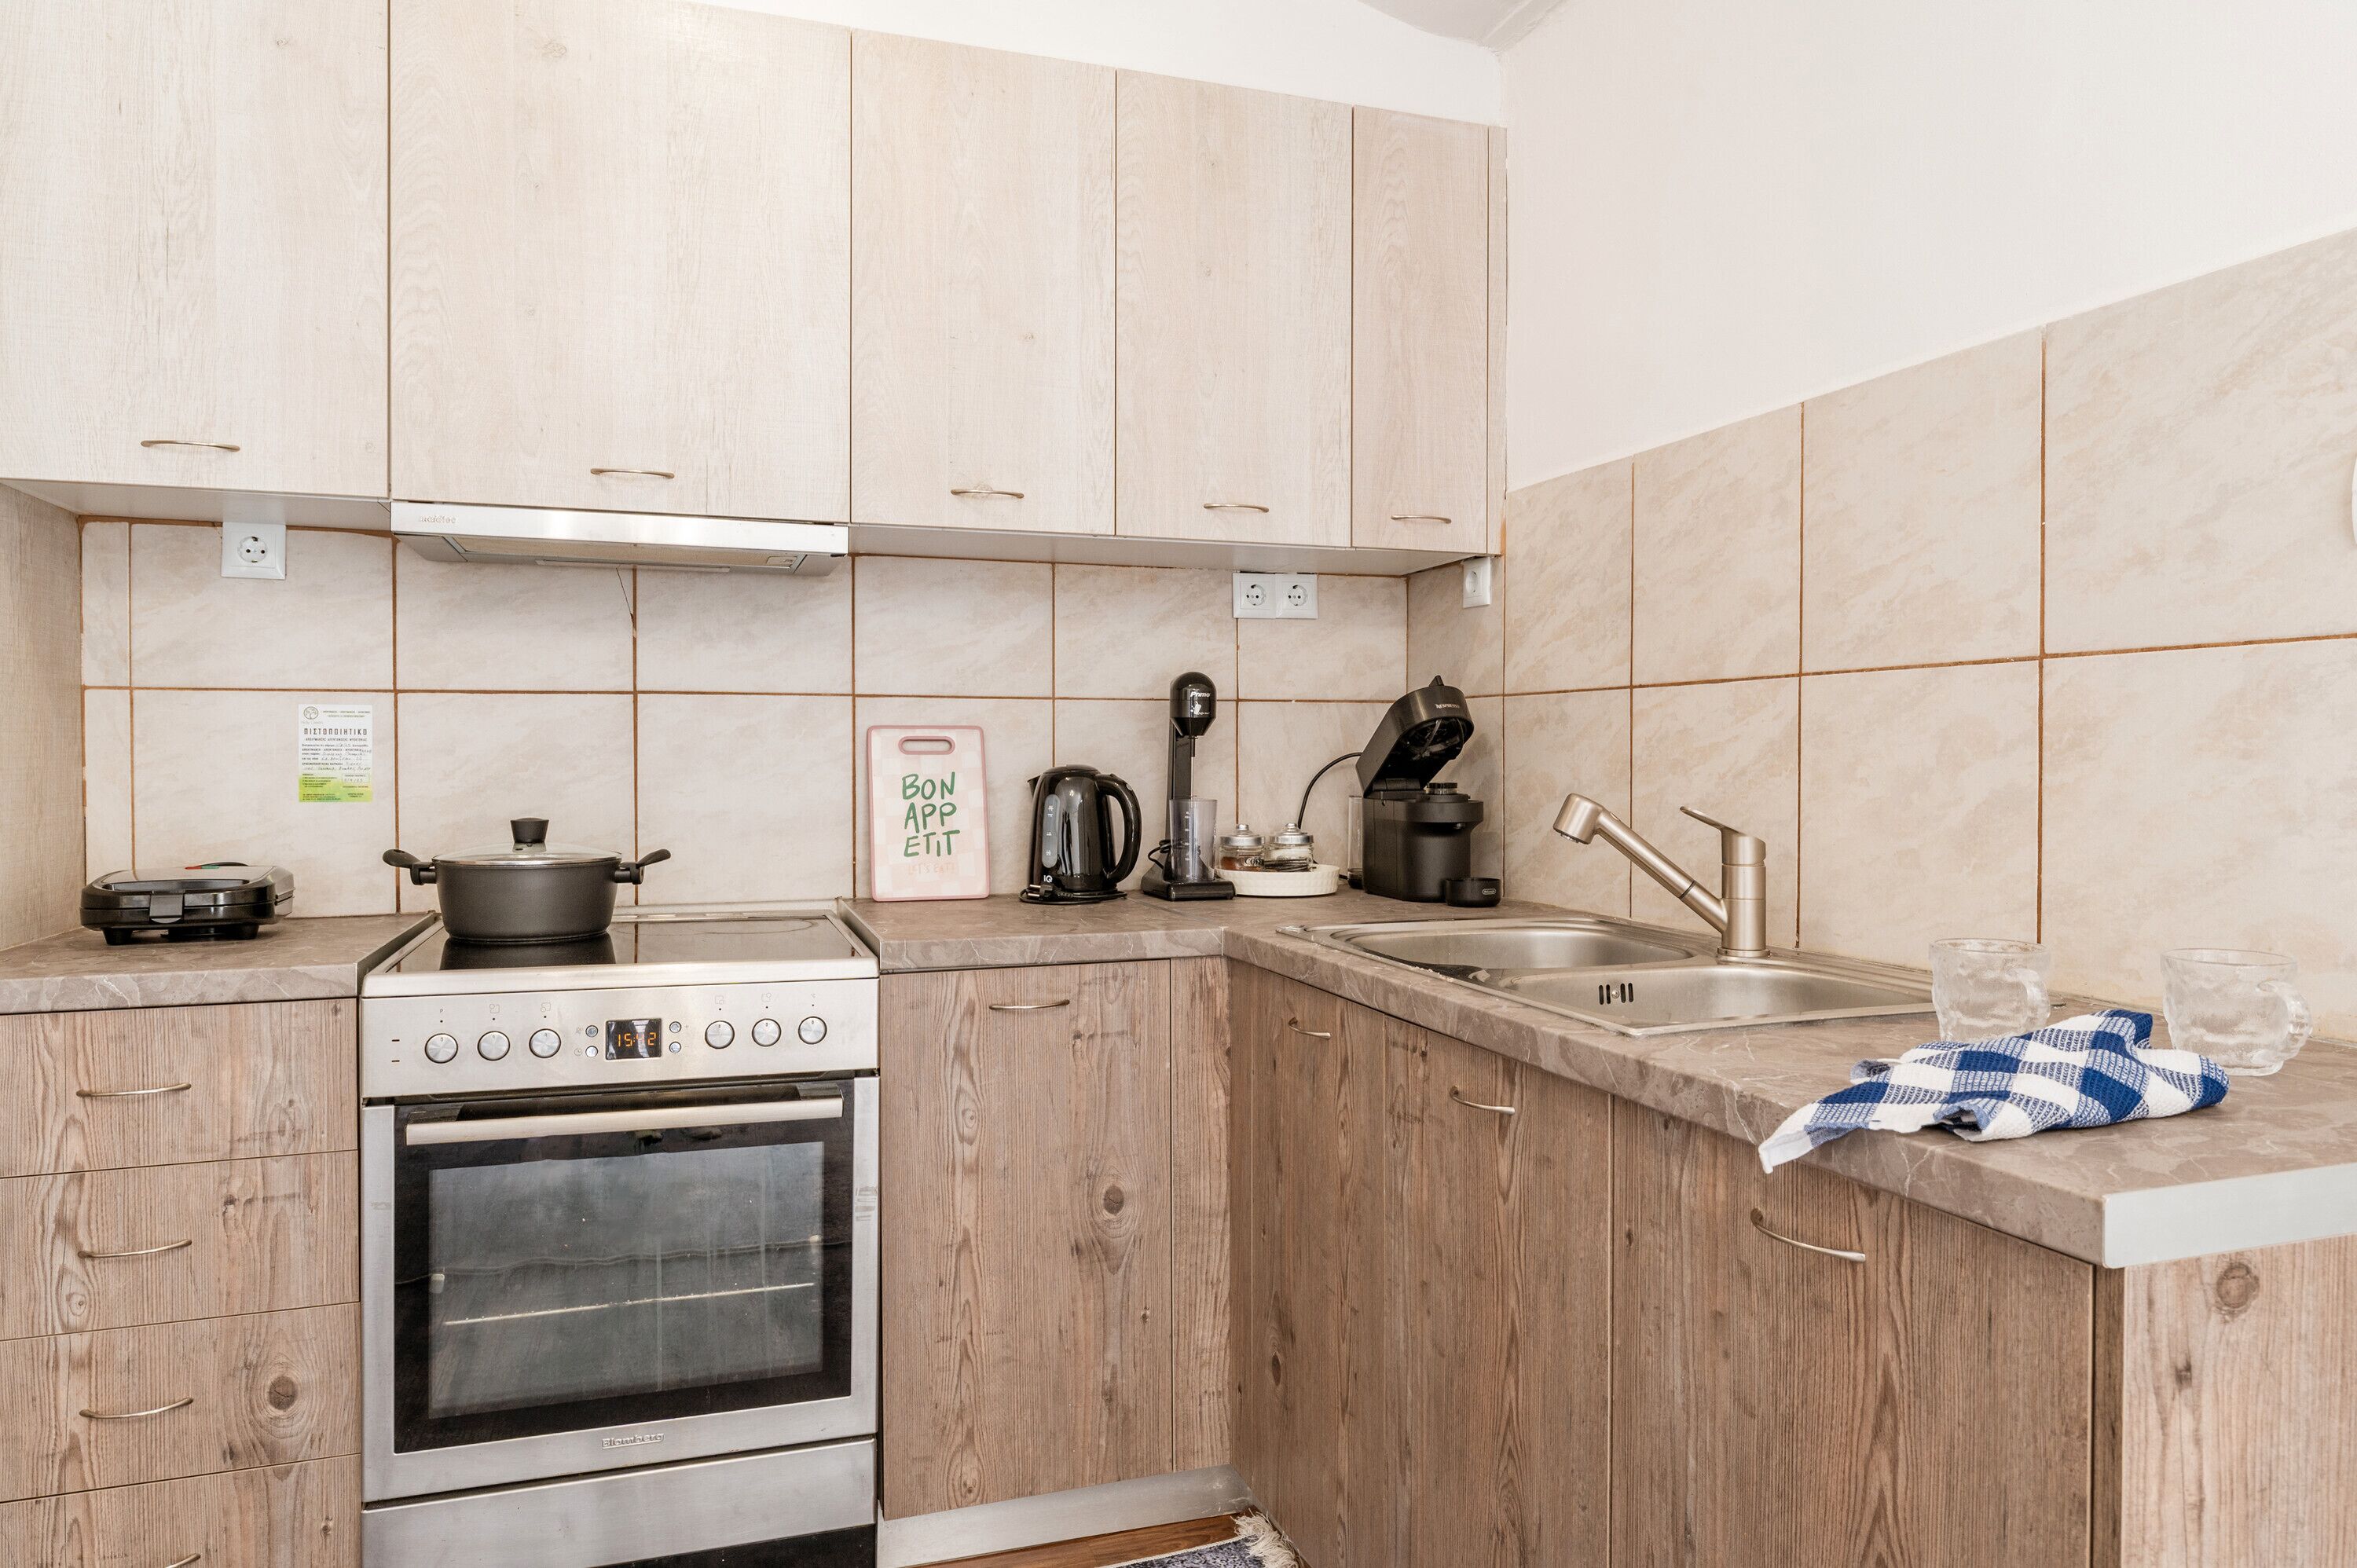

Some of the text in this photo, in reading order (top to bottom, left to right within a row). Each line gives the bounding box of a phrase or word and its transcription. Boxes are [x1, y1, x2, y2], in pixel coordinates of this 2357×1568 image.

[304, 727, 368, 736] ΠΙΣΤΟΠΟΙΗΤΙΚΟ
[901, 771, 955, 800] BON
[904, 801, 957, 833] APP
[1043, 874, 1053, 883] IQ
[618, 1031, 657, 1047] 15:42
[602, 1433, 664, 1448] Blomberg
